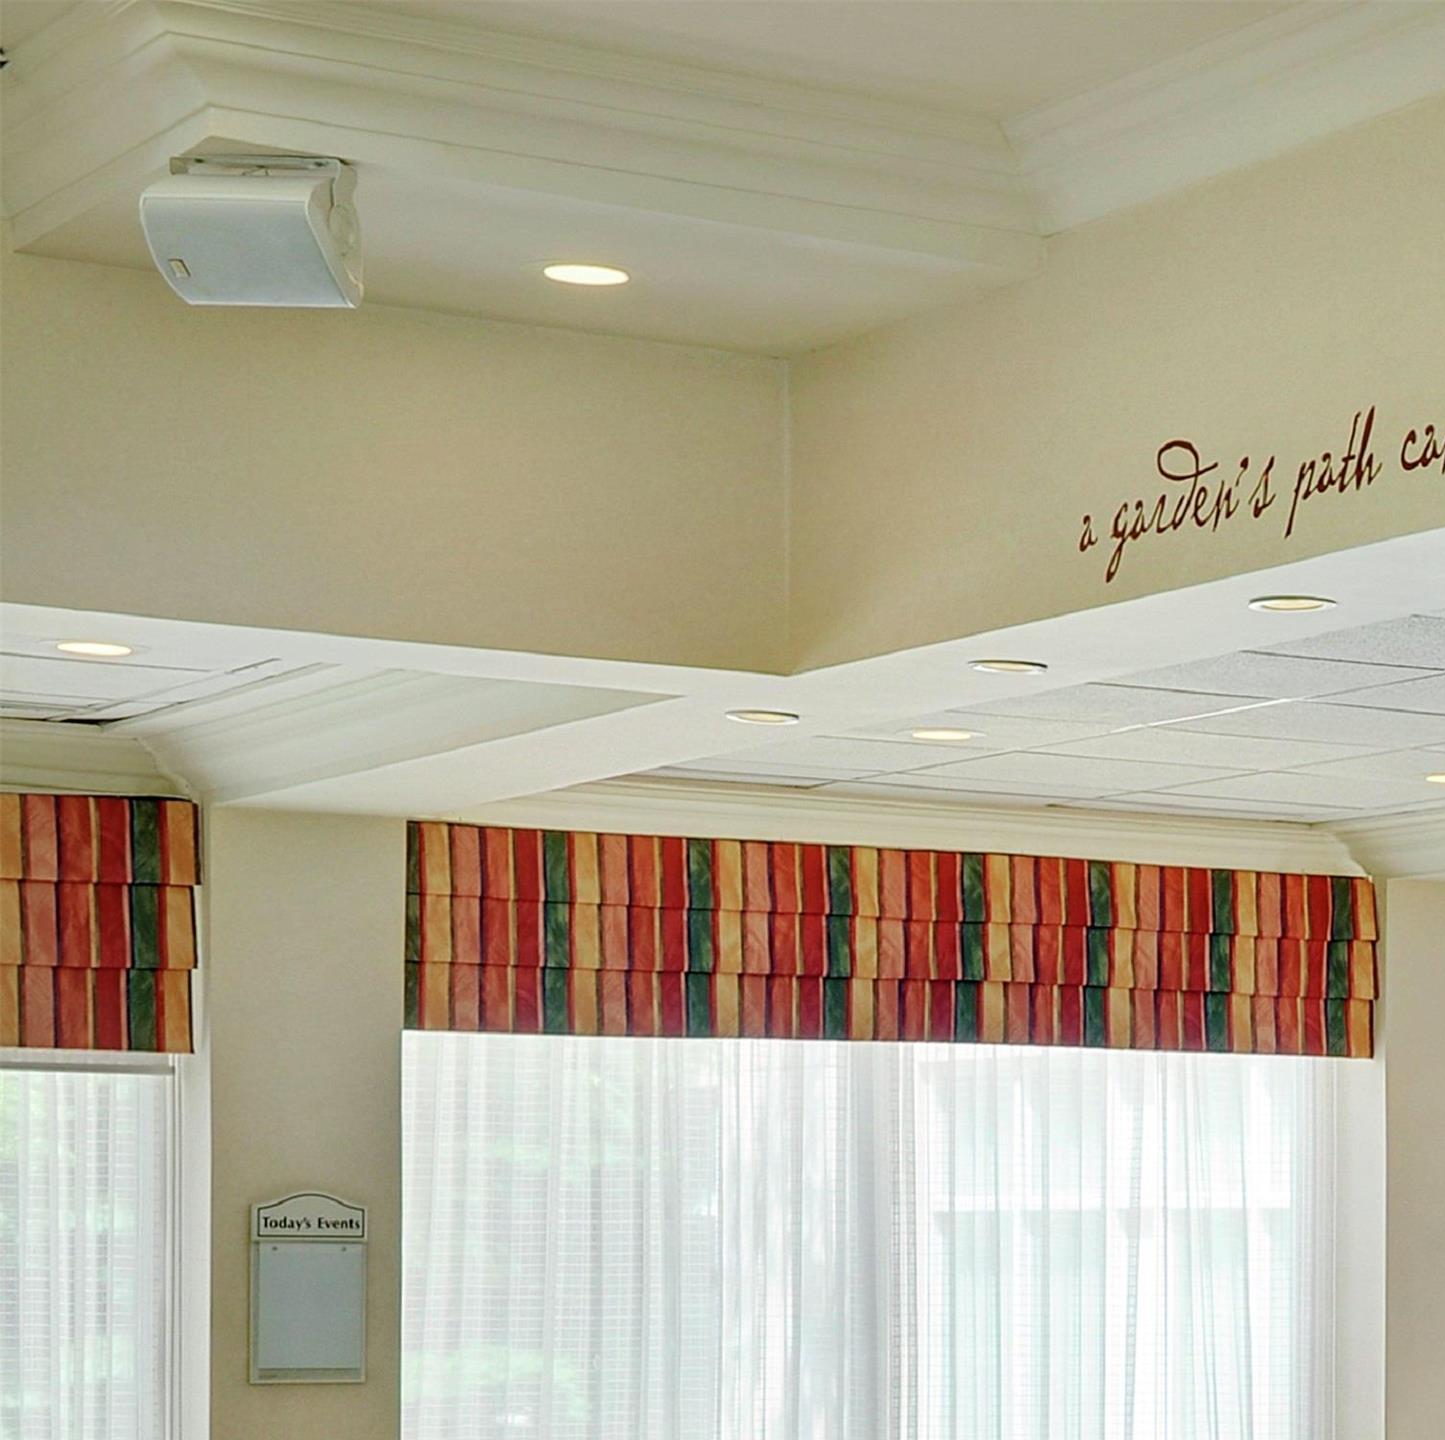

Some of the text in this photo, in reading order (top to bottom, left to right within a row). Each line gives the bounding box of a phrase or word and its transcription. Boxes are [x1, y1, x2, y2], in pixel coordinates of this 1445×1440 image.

[1078, 514, 1099, 553] a
[1105, 439, 1277, 584] garden's
[1283, 404, 1383, 540] path
[262, 1215, 361, 1232] Today's Events
